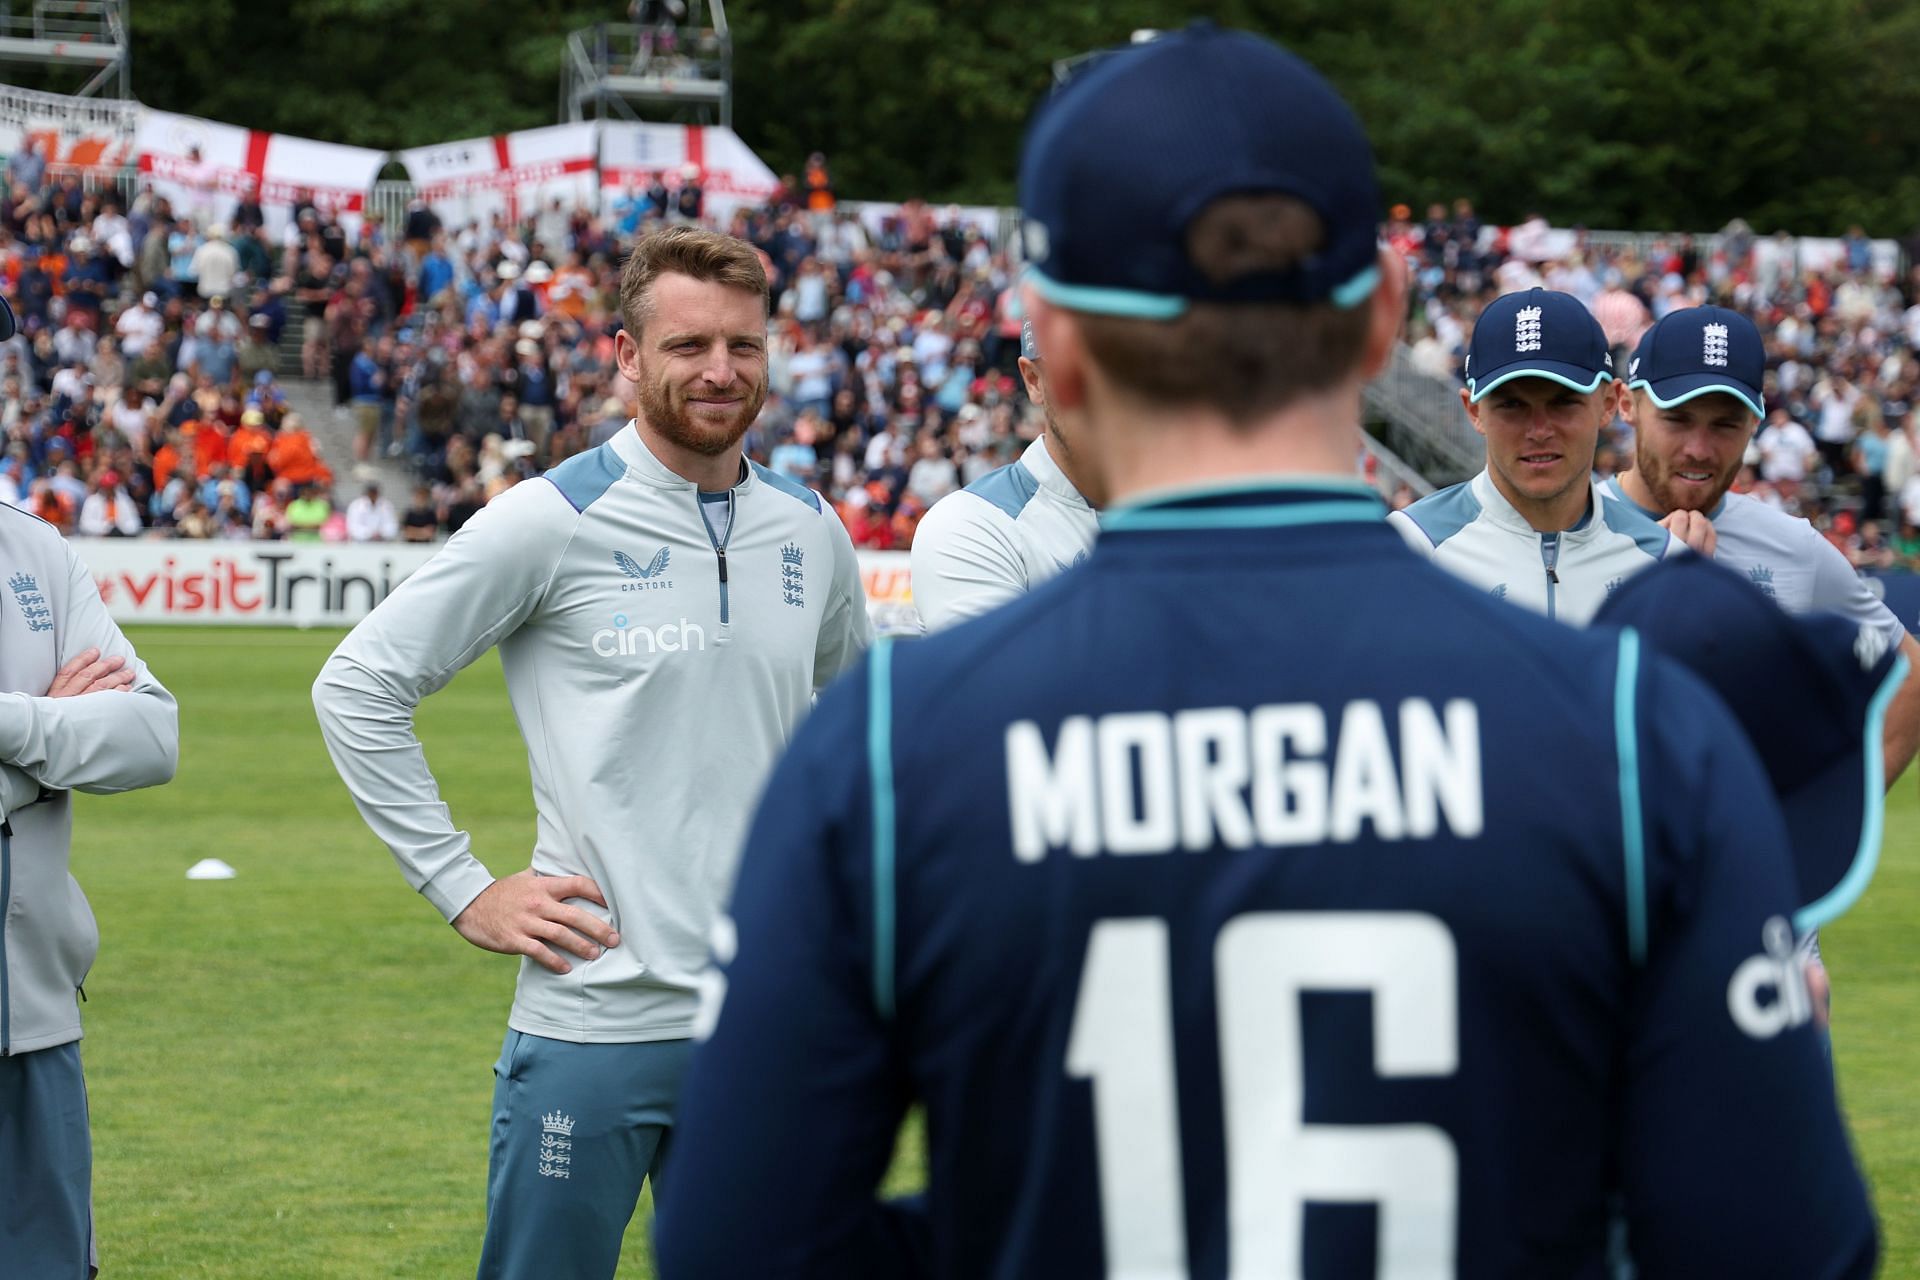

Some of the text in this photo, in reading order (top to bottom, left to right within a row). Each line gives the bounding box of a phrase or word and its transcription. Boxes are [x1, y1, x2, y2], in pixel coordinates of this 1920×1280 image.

[591, 613, 705, 657] cinch
[621, 580, 673, 592] CASTORE
[1005, 698, 1485, 863] MORGAN
[1064, 911, 1459, 1280] 16
